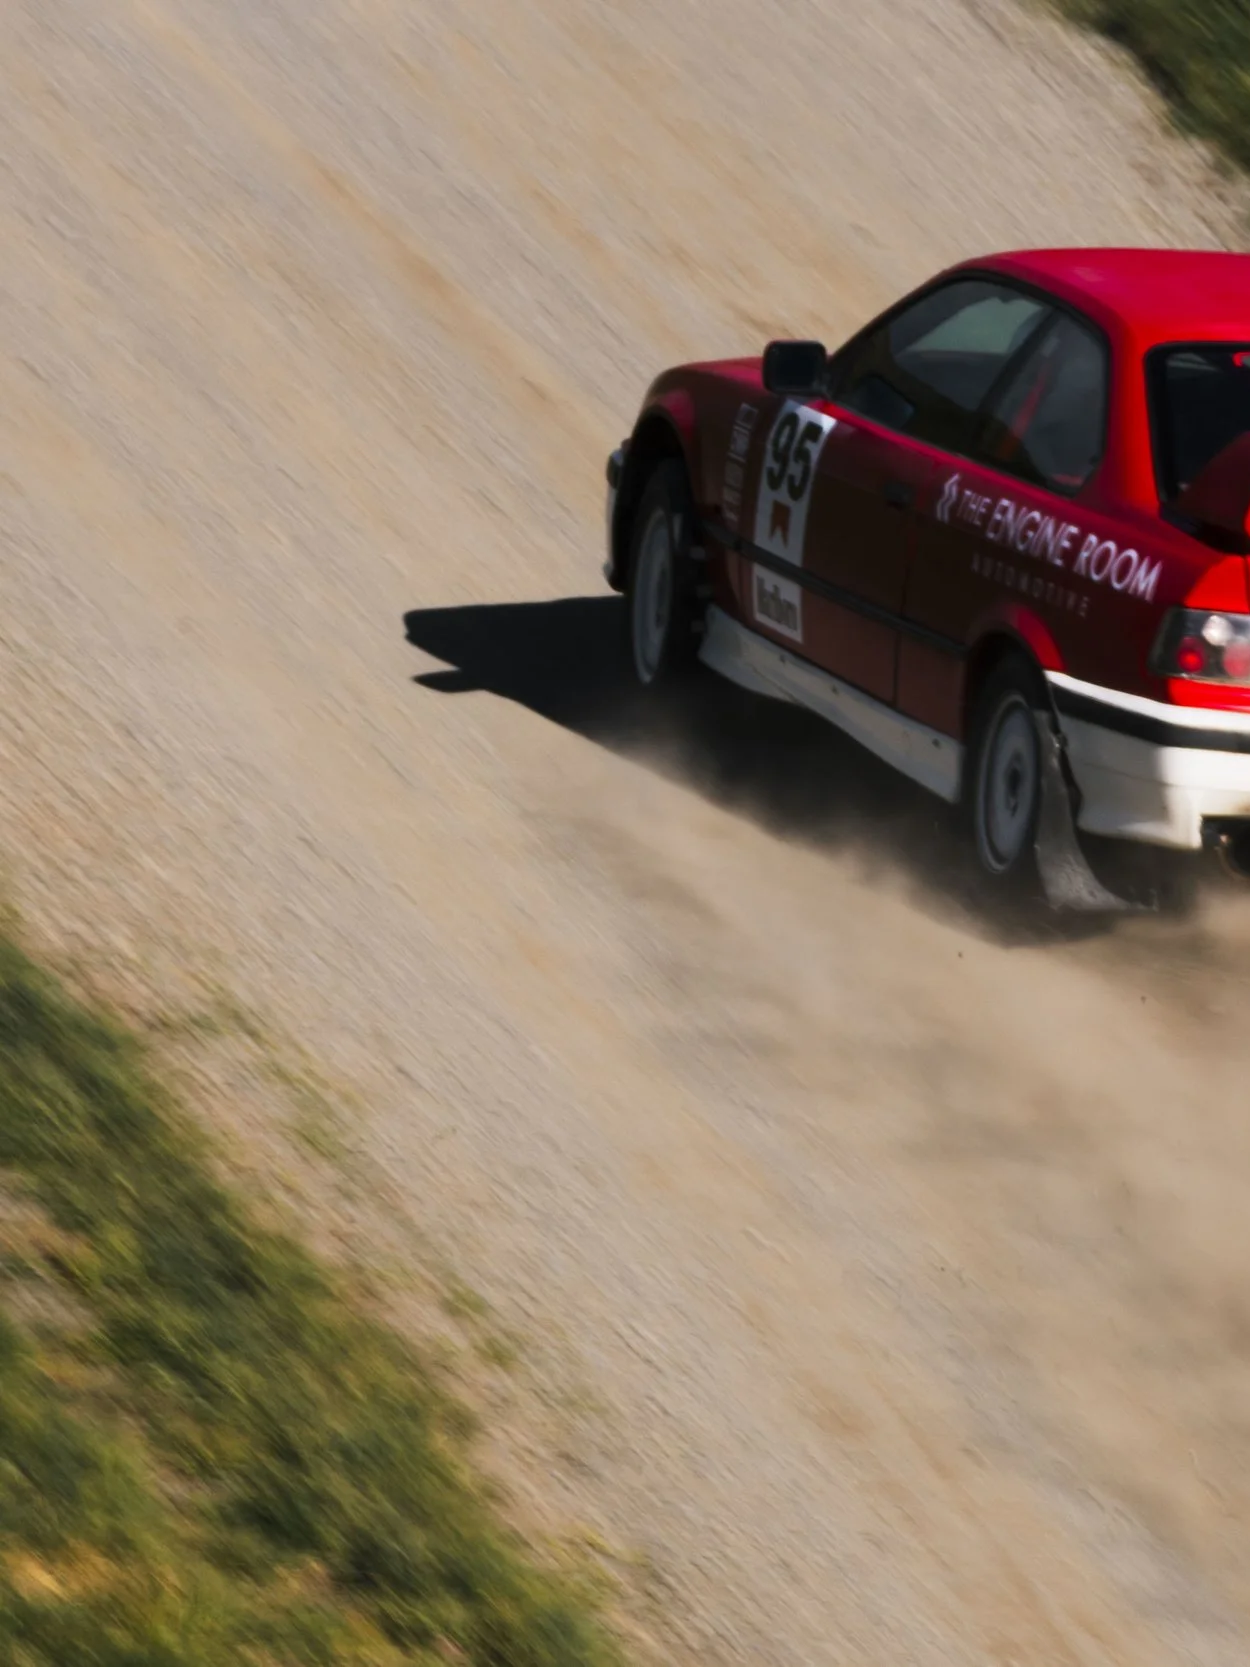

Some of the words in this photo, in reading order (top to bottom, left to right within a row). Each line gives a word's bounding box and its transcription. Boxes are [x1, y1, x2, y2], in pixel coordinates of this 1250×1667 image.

[766, 411, 824, 501] 95
[957, 489, 992, 525] THE
[985, 498, 1080, 567] ENGINE
[1073, 532, 1163, 603] ROOM
